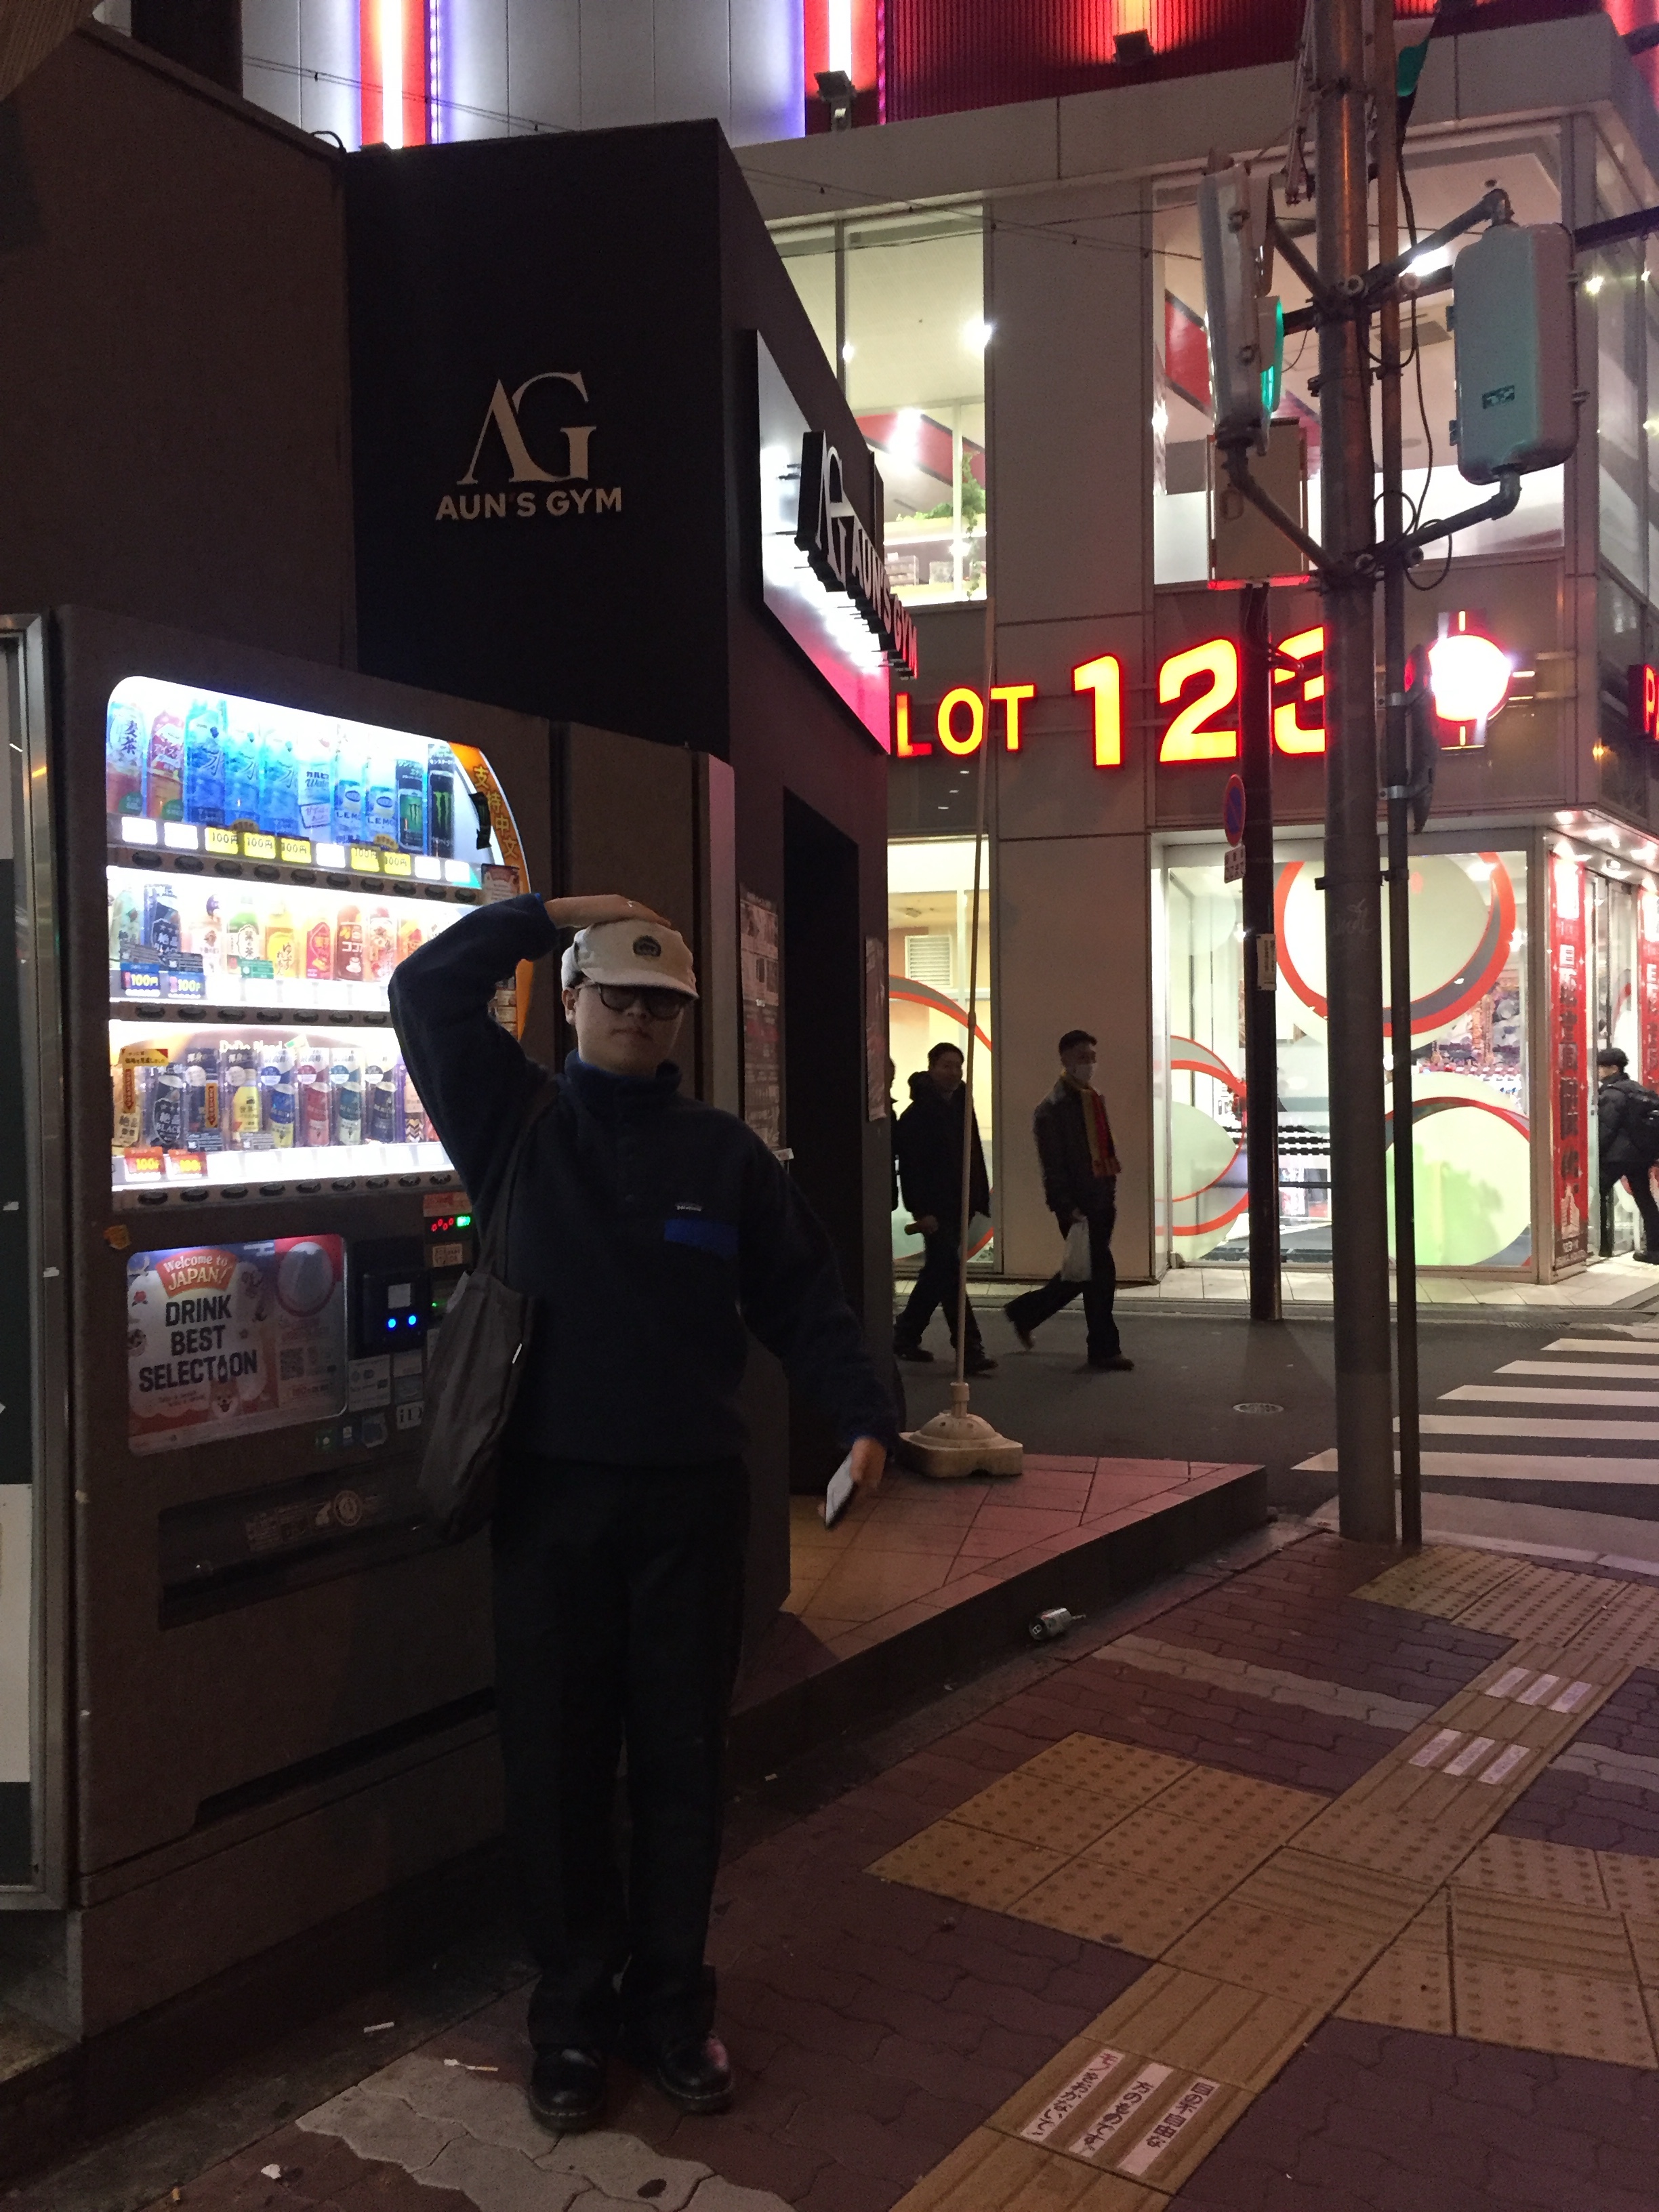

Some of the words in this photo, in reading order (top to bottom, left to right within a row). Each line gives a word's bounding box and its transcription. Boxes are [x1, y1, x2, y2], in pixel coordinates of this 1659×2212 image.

[456, 370, 597, 485] AG
[546, 487, 621, 516] GYM
[893, 594, 918, 680] GYM
[474, 764, 518, 859] 支持中文
[247, 837, 272, 849] 100円
[163, 1254, 213, 1273] Welcome
[168, 1266, 229, 1291] JAPAN!
[165, 1294, 232, 1328] DRINK
[171, 1324, 226, 1357] BEST
